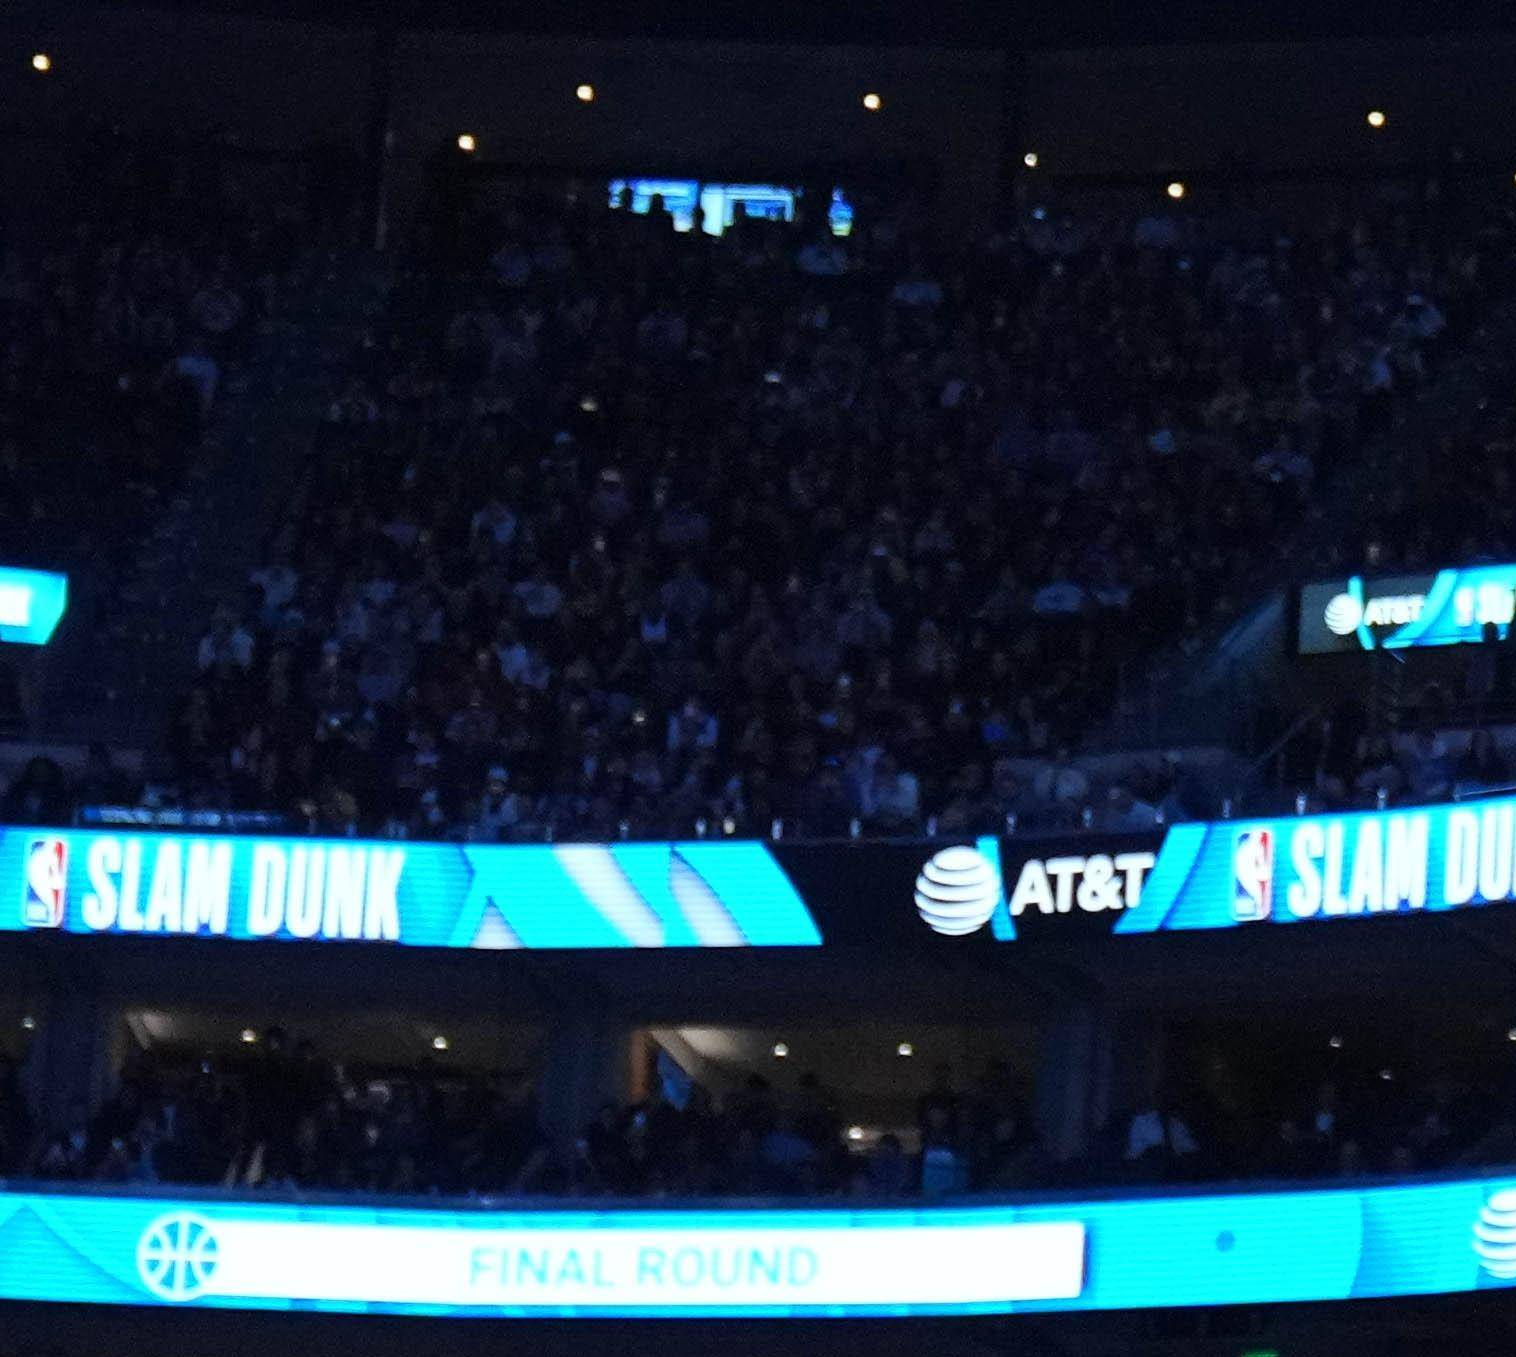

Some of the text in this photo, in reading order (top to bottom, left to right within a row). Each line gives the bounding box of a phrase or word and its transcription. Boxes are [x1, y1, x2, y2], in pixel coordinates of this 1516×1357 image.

[81, 836, 404, 943] SLAM DUNK
[1009, 851, 1157, 916] AT&T
[1287, 808, 1425, 918] SLAM
[468, 1246, 820, 1290] FINAL ROUND
